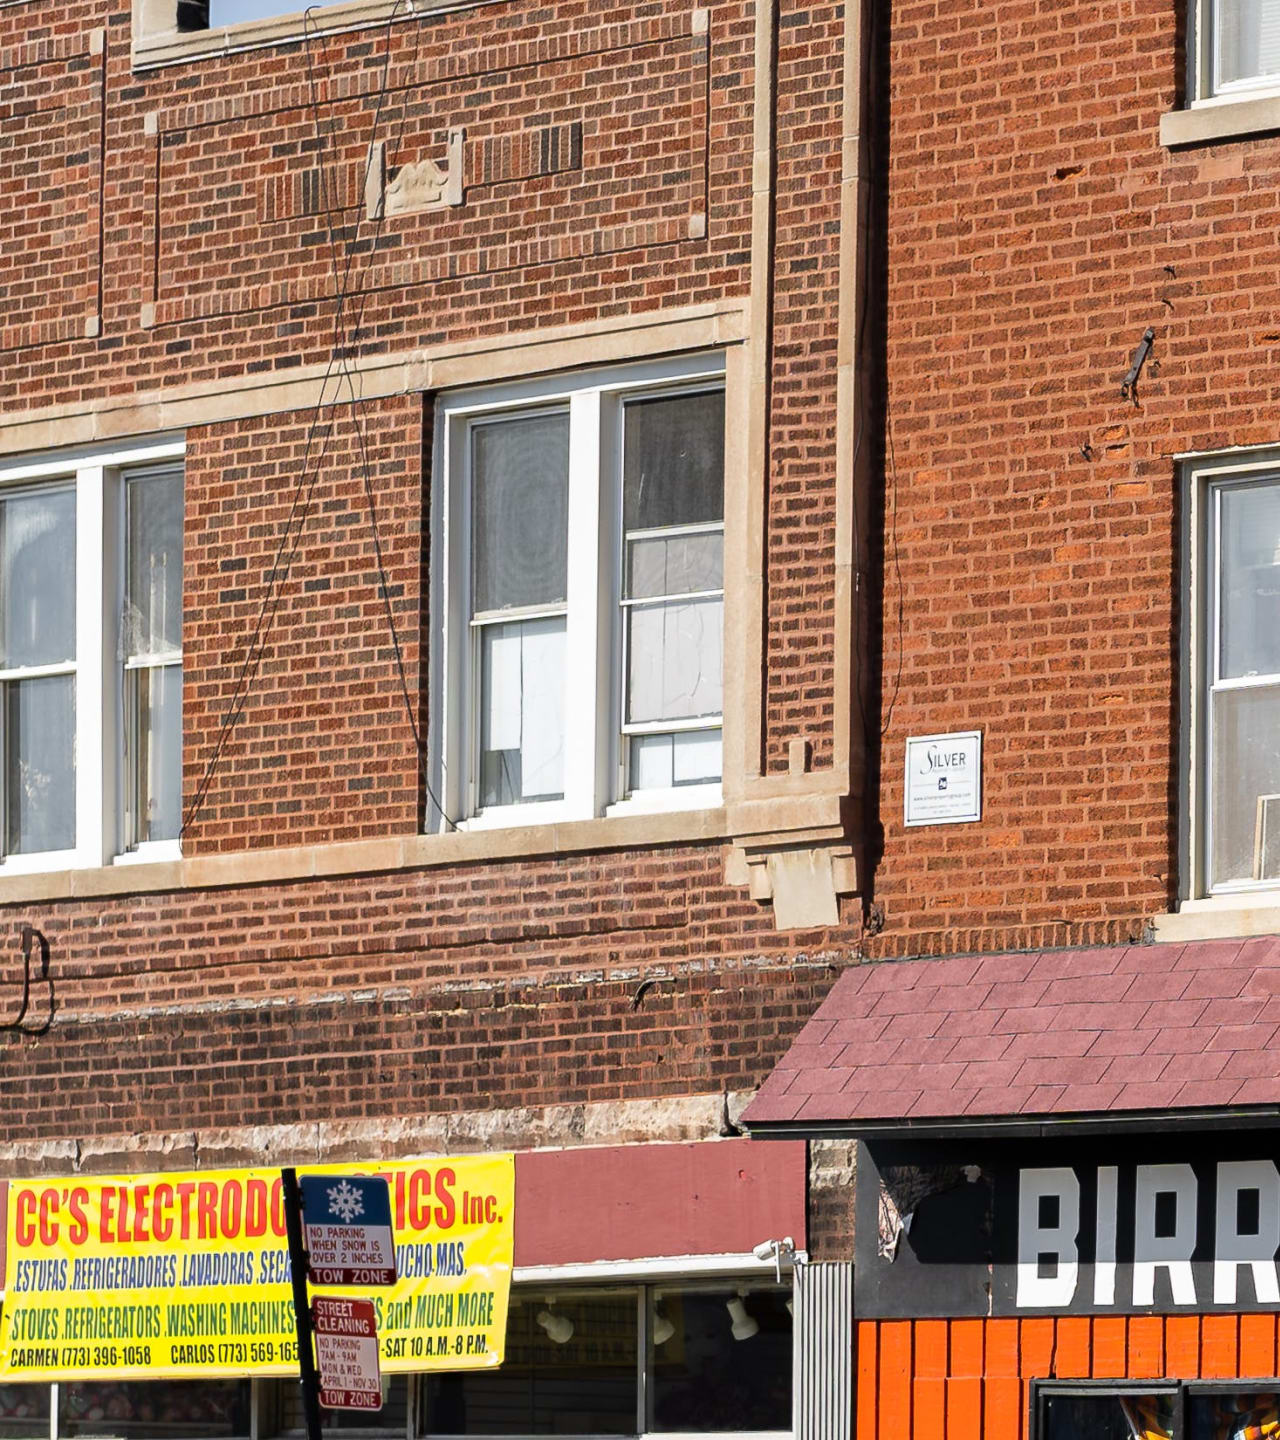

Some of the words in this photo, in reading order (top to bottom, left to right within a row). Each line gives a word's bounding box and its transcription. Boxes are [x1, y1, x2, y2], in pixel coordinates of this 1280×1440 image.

[920, 745, 966, 774] SILVER
[462, 1191, 503, 1225] Inc.
[310, 1227, 322, 1238] NO
[327, 1228, 366, 1239] PARKING
[312, 1240, 336, 1250] WHEN
[342, 1240, 366, 1251] SNOW
[371, 1240, 380, 1251] IS
[312, 1252, 336, 1263] OVER
[340, 1252, 348, 1264] 2
[352, 1253, 384, 1264] INCHES
[396, 1243, 432, 1278] UCHO
[314, 1268, 344, 1284] TOW
[352, 1269, 390, 1284] ZONE
[316, 1300, 354, 1317] STREET
[386, 1296, 412, 1330] and
[414, 1293, 454, 1328] MUCH
[456, 1292, 495, 1327] MORE
[317, 1316, 370, 1334] CLEANING
[10, 1348, 58, 1368] CARMEN
[62, 1348, 90, 1366] (773)
[94, 1346, 152, 1366] 396-1058
[170, 1344, 215, 1364] CARLOS
[218, 1343, 248, 1363] (773)
[250, 1342, 300, 1362] 569-165
[410, 1336, 422, 1356] 10
[320, 1338, 330, 1350] NO
[332, 1338, 361, 1350] PARKING
[324, 1376, 342, 1388] APRIL
[324, 1390, 346, 1405] TOW
[350, 1392, 377, 1407] ZONE
